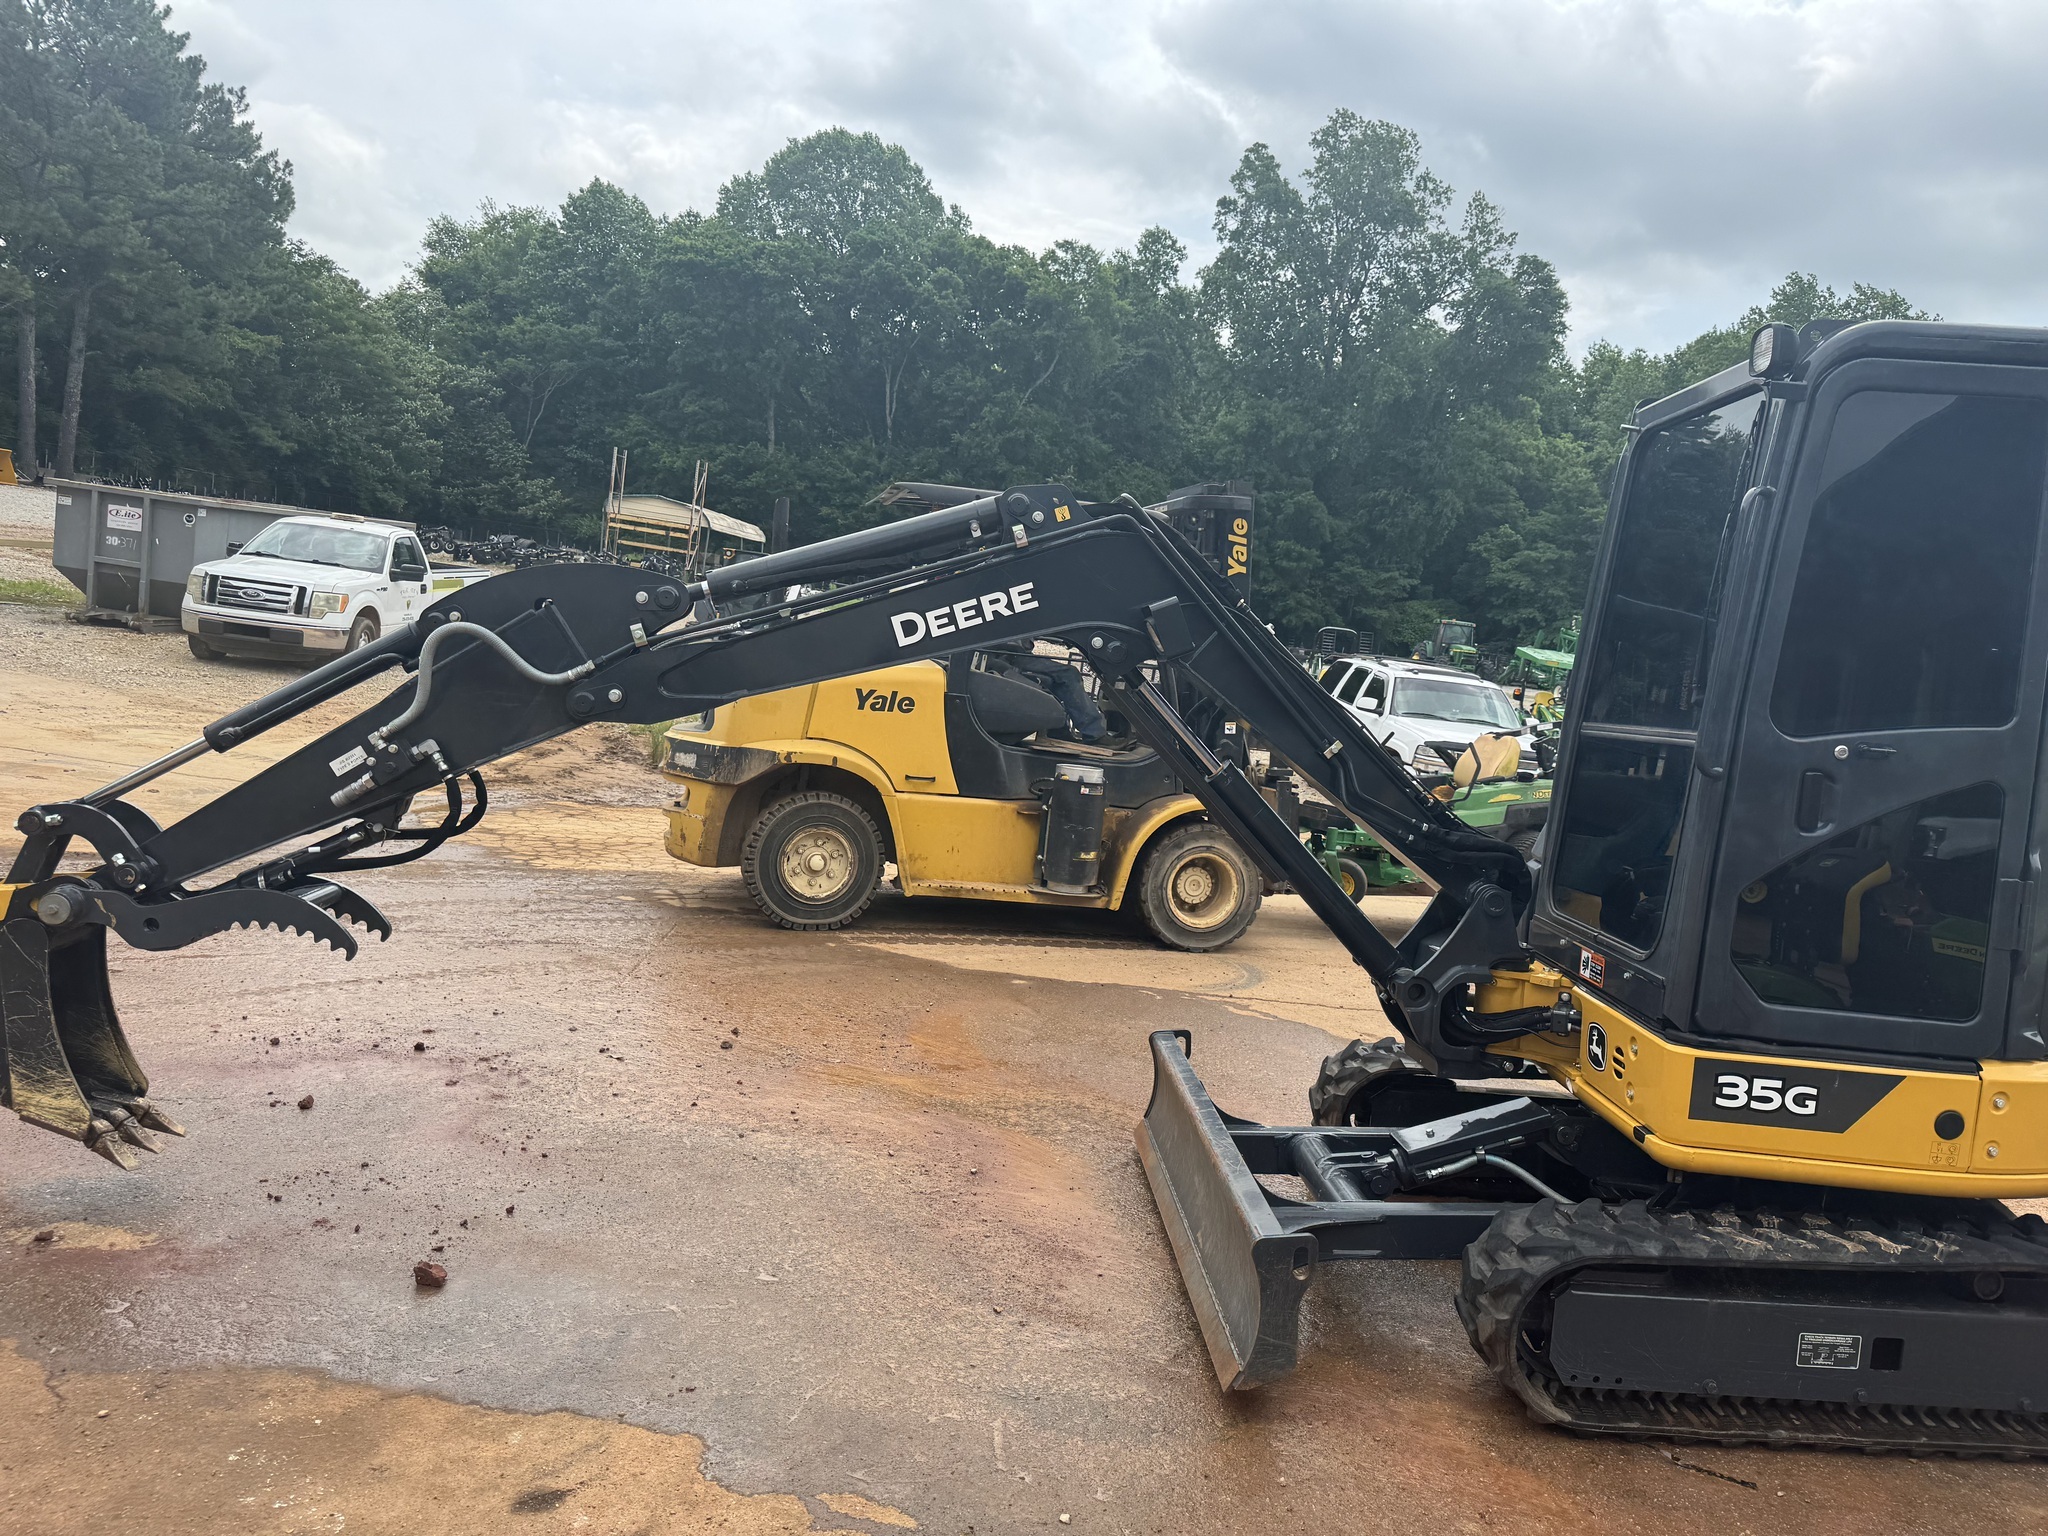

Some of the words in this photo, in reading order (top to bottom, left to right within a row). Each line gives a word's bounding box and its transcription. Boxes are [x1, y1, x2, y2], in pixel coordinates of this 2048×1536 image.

[1228, 518, 1248, 576] Yale
[891, 582, 1039, 647] DEERE
[855, 688, 915, 713] Yale
[1715, 1075, 1818, 1115] 35G
